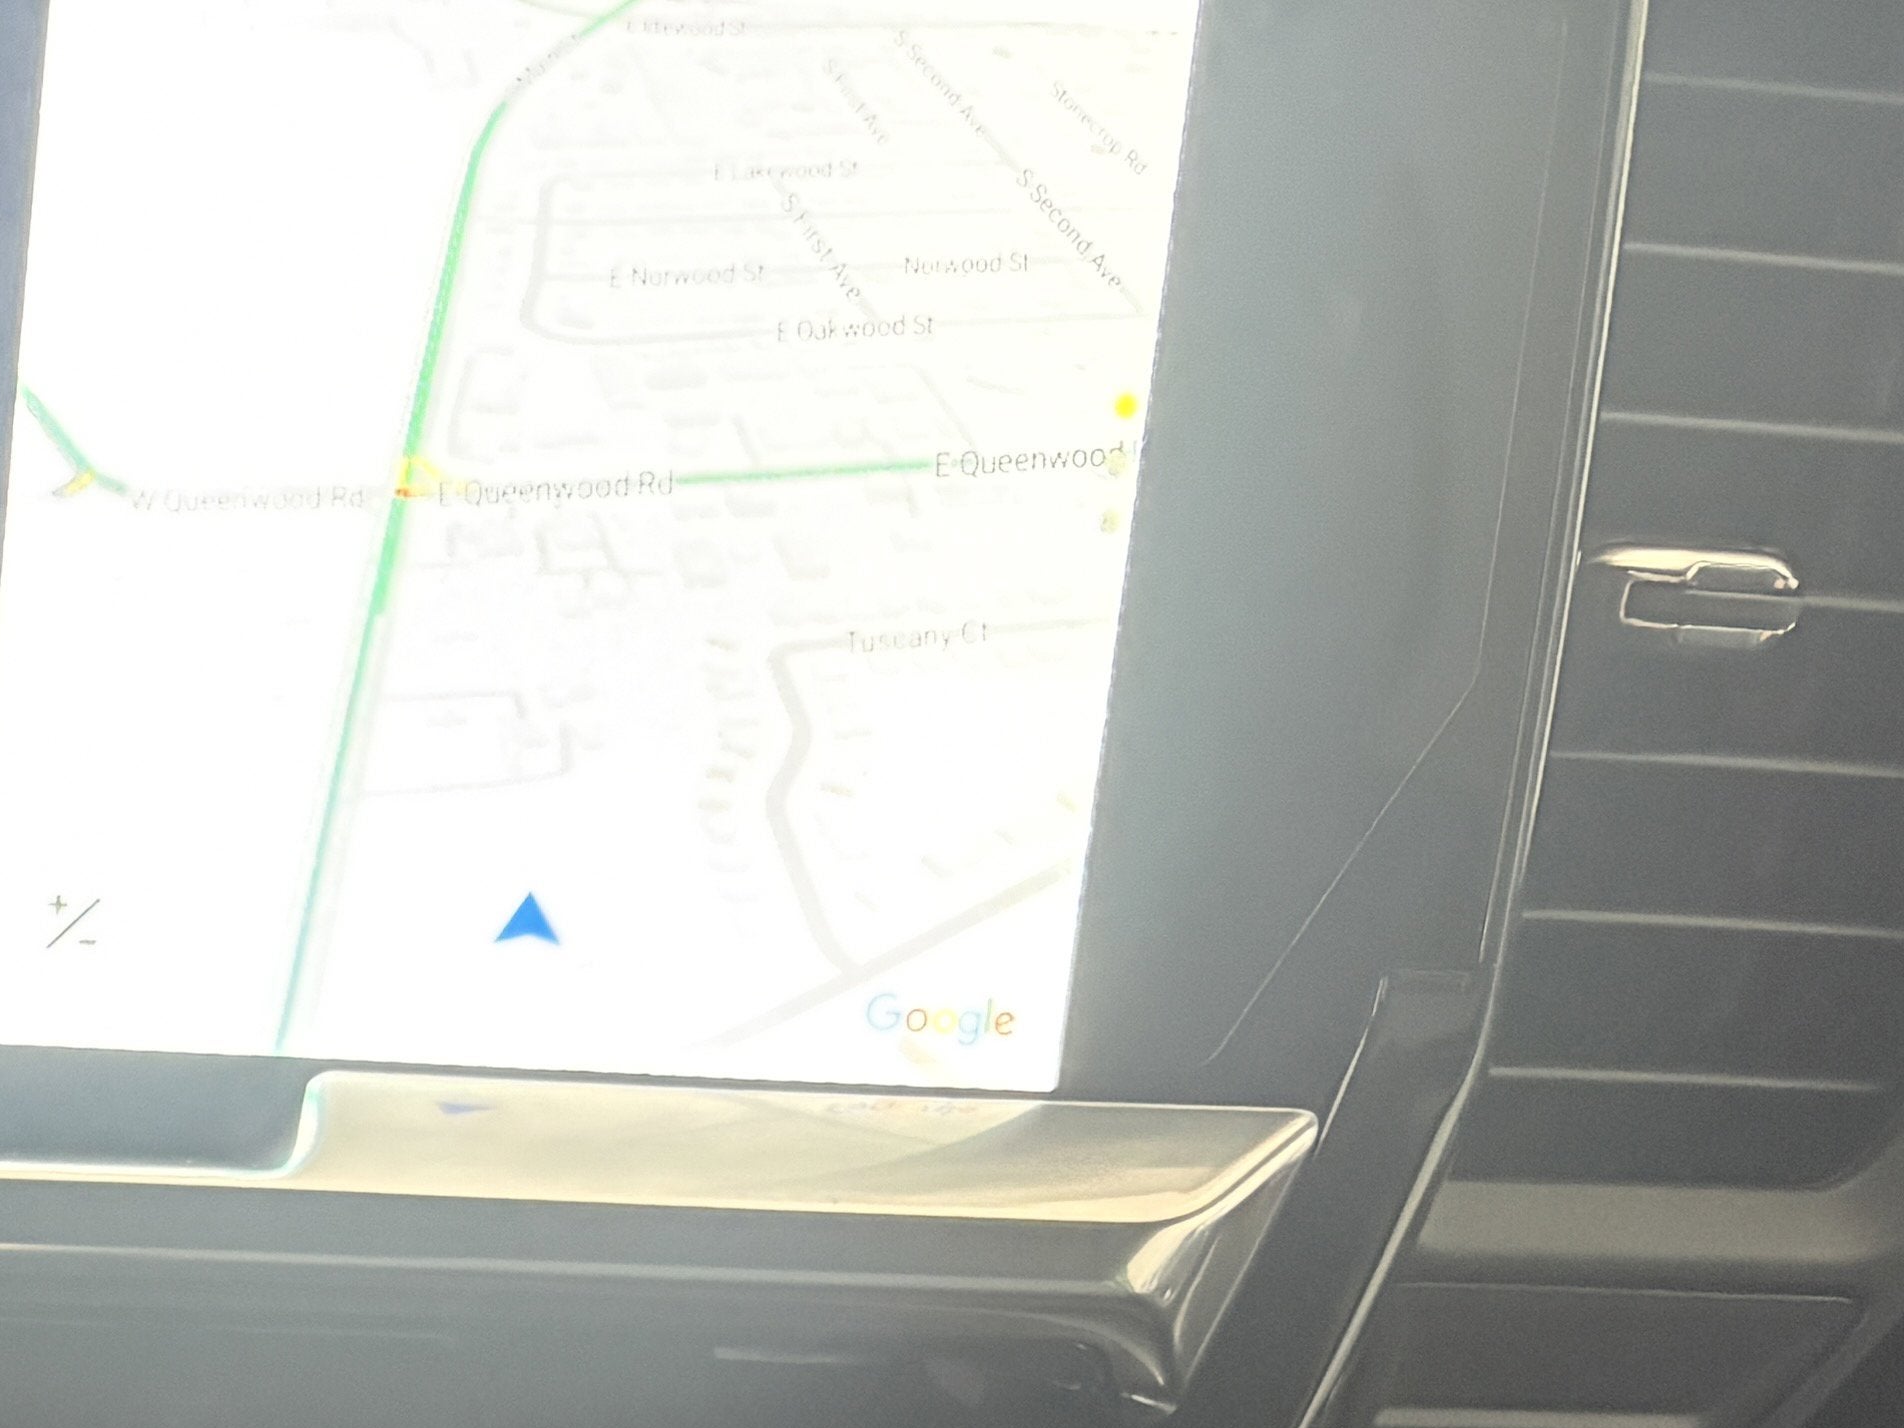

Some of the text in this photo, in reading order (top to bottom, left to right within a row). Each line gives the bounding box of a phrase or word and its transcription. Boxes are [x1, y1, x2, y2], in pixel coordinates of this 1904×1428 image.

[906, 41, 964, 107] Second
[959, 103, 986, 139] Ave
[1123, 147, 1149, 176] Rd
[1016, 167, 1122, 291] S Second Ave
[830, 261, 862, 302] Ave
[912, 315, 934, 336] St
[936, 451, 950, 478] E
[464, 476, 630, 507] Queenwood
[637, 469, 674, 497] Rd
[865, 992, 1016, 1046] Google
